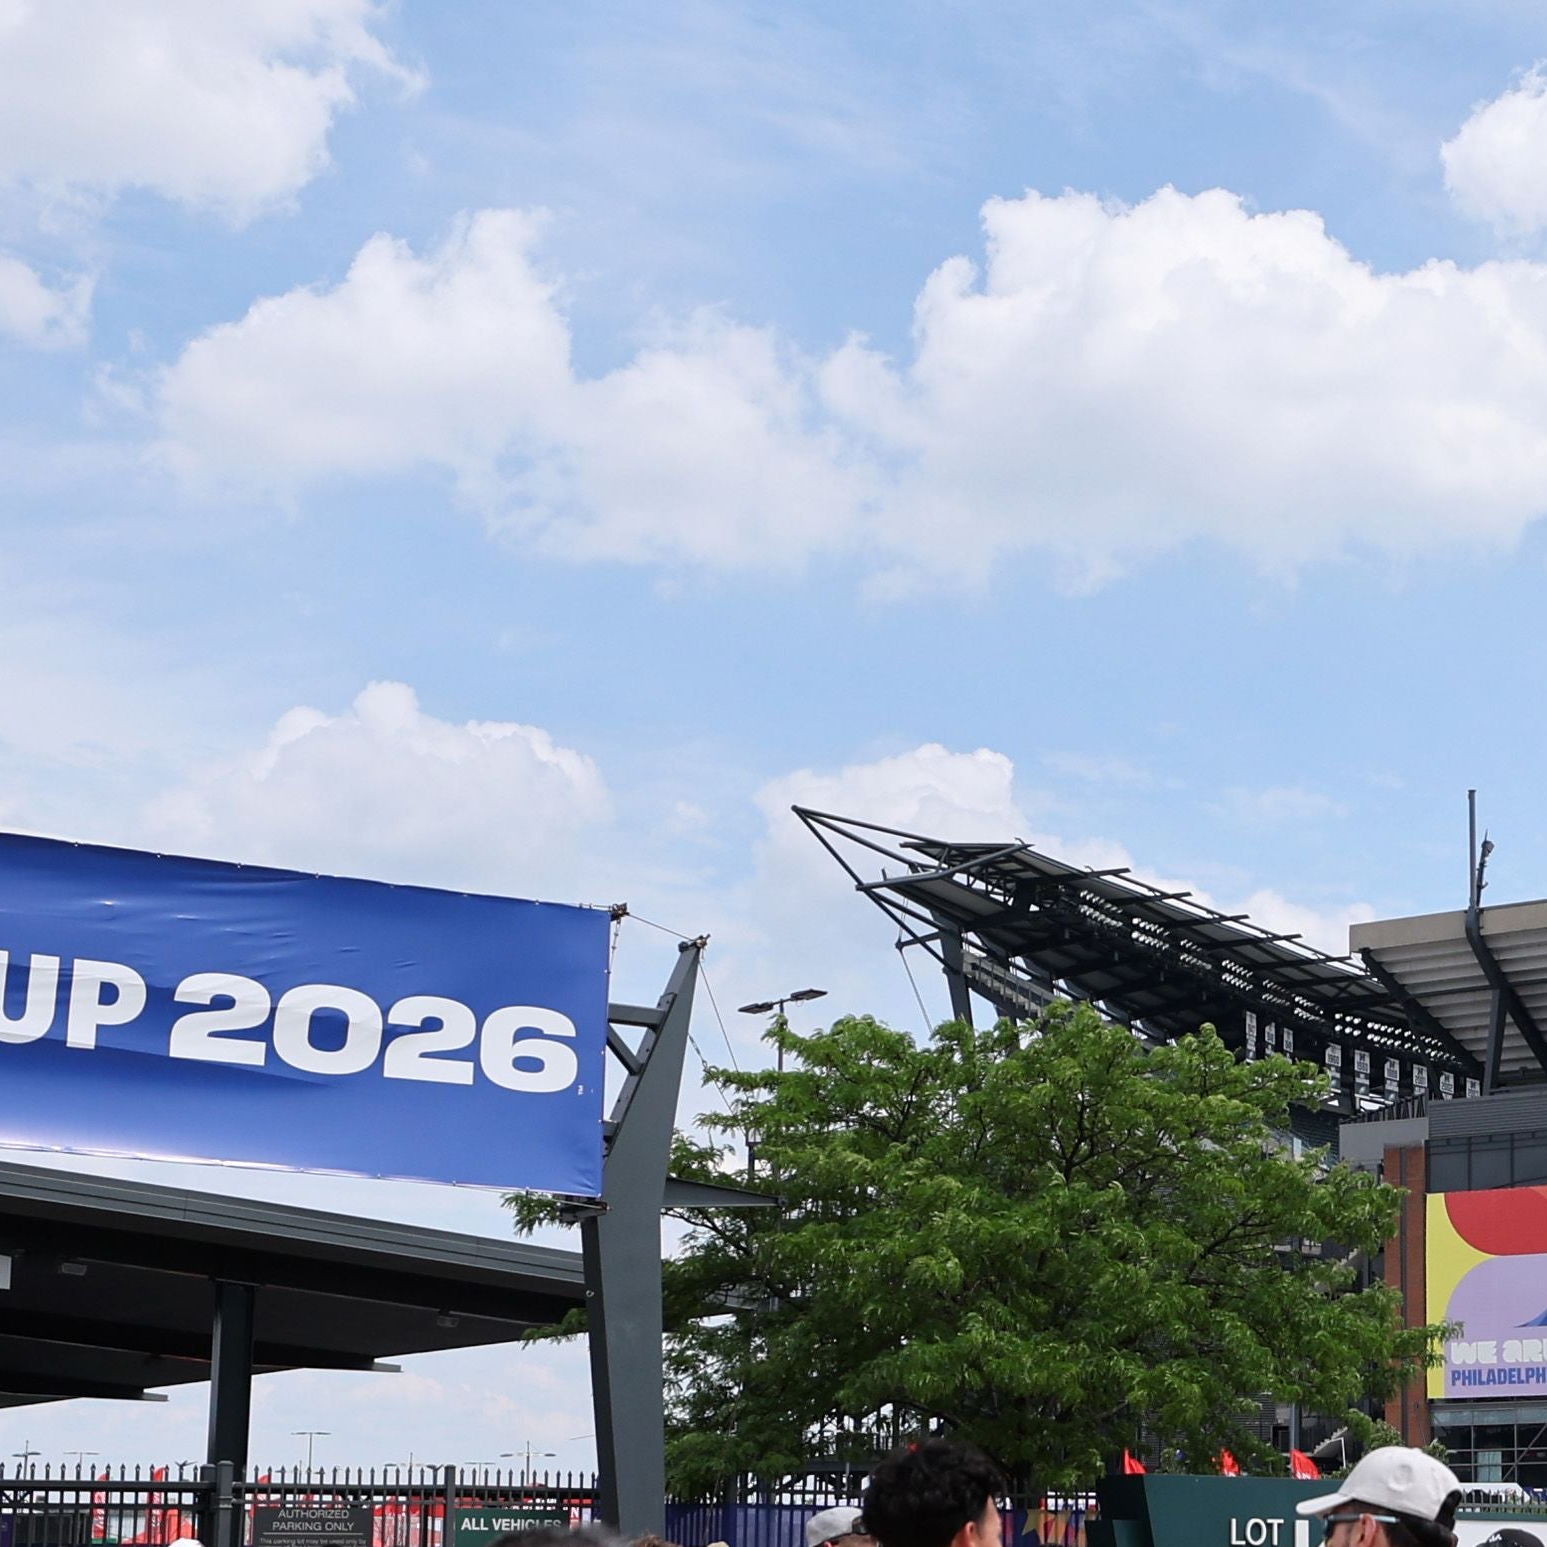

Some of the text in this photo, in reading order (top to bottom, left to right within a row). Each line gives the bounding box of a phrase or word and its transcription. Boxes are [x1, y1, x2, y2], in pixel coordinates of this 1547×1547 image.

[169, 972, 579, 1093] 2026
[1451, 1341, 1497, 1364] WE
[278, 1510, 349, 1518] AUTHORIZED
[273, 1522, 355, 1531] PARKING ONLY
[461, 1518, 562, 1531] ALL VEHICLES
[1230, 1518, 1284, 1545] LOT
